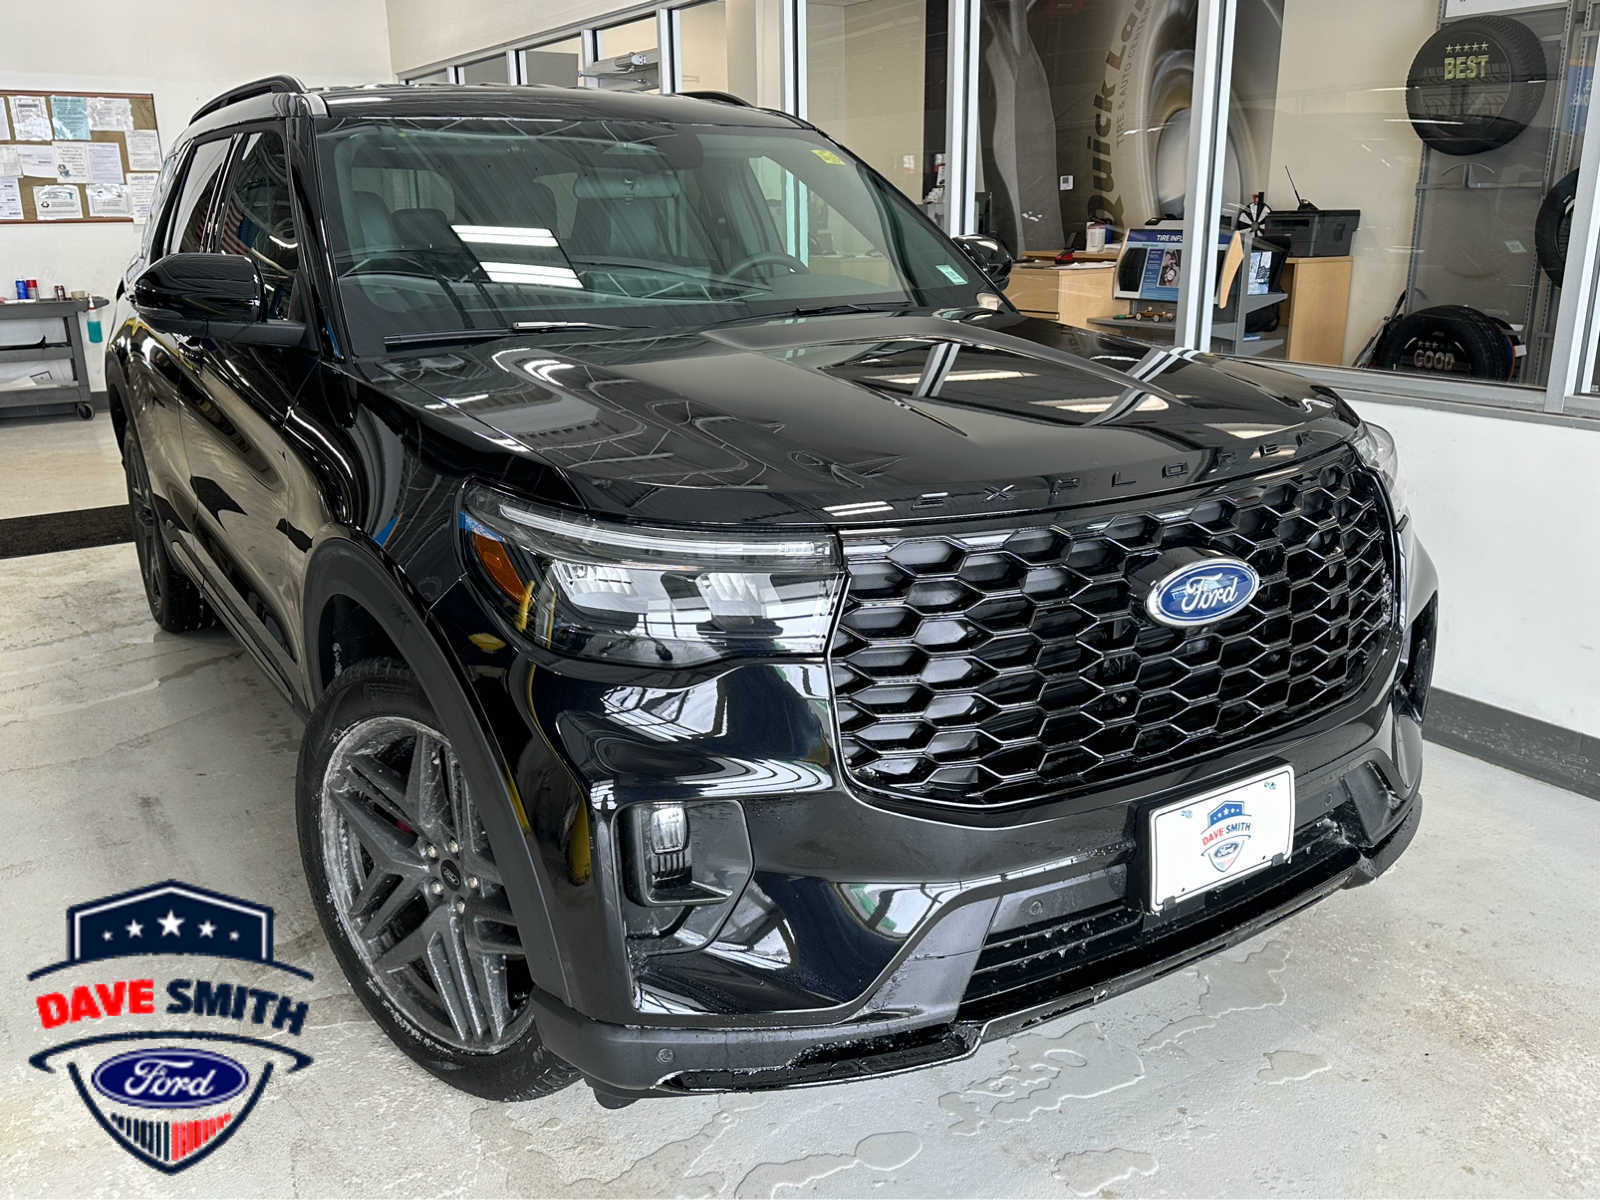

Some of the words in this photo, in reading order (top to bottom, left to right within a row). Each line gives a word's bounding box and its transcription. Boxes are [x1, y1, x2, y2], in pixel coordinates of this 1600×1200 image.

[1105, 0, 1146, 71] La
[1119, 63, 1131, 96] AUTO
[1444, 55, 1488, 80] BEST
[1116, 114, 1126, 148] TIRE
[1087, 80, 1124, 236] Quick
[1413, 350, 1455, 371] GOOD
[911, 430, 1314, 510] EXPLORER
[1181, 573, 1239, 613] Ford
[1202, 827, 1224, 846] DAVE
[1226, 822, 1251, 834] SMITH
